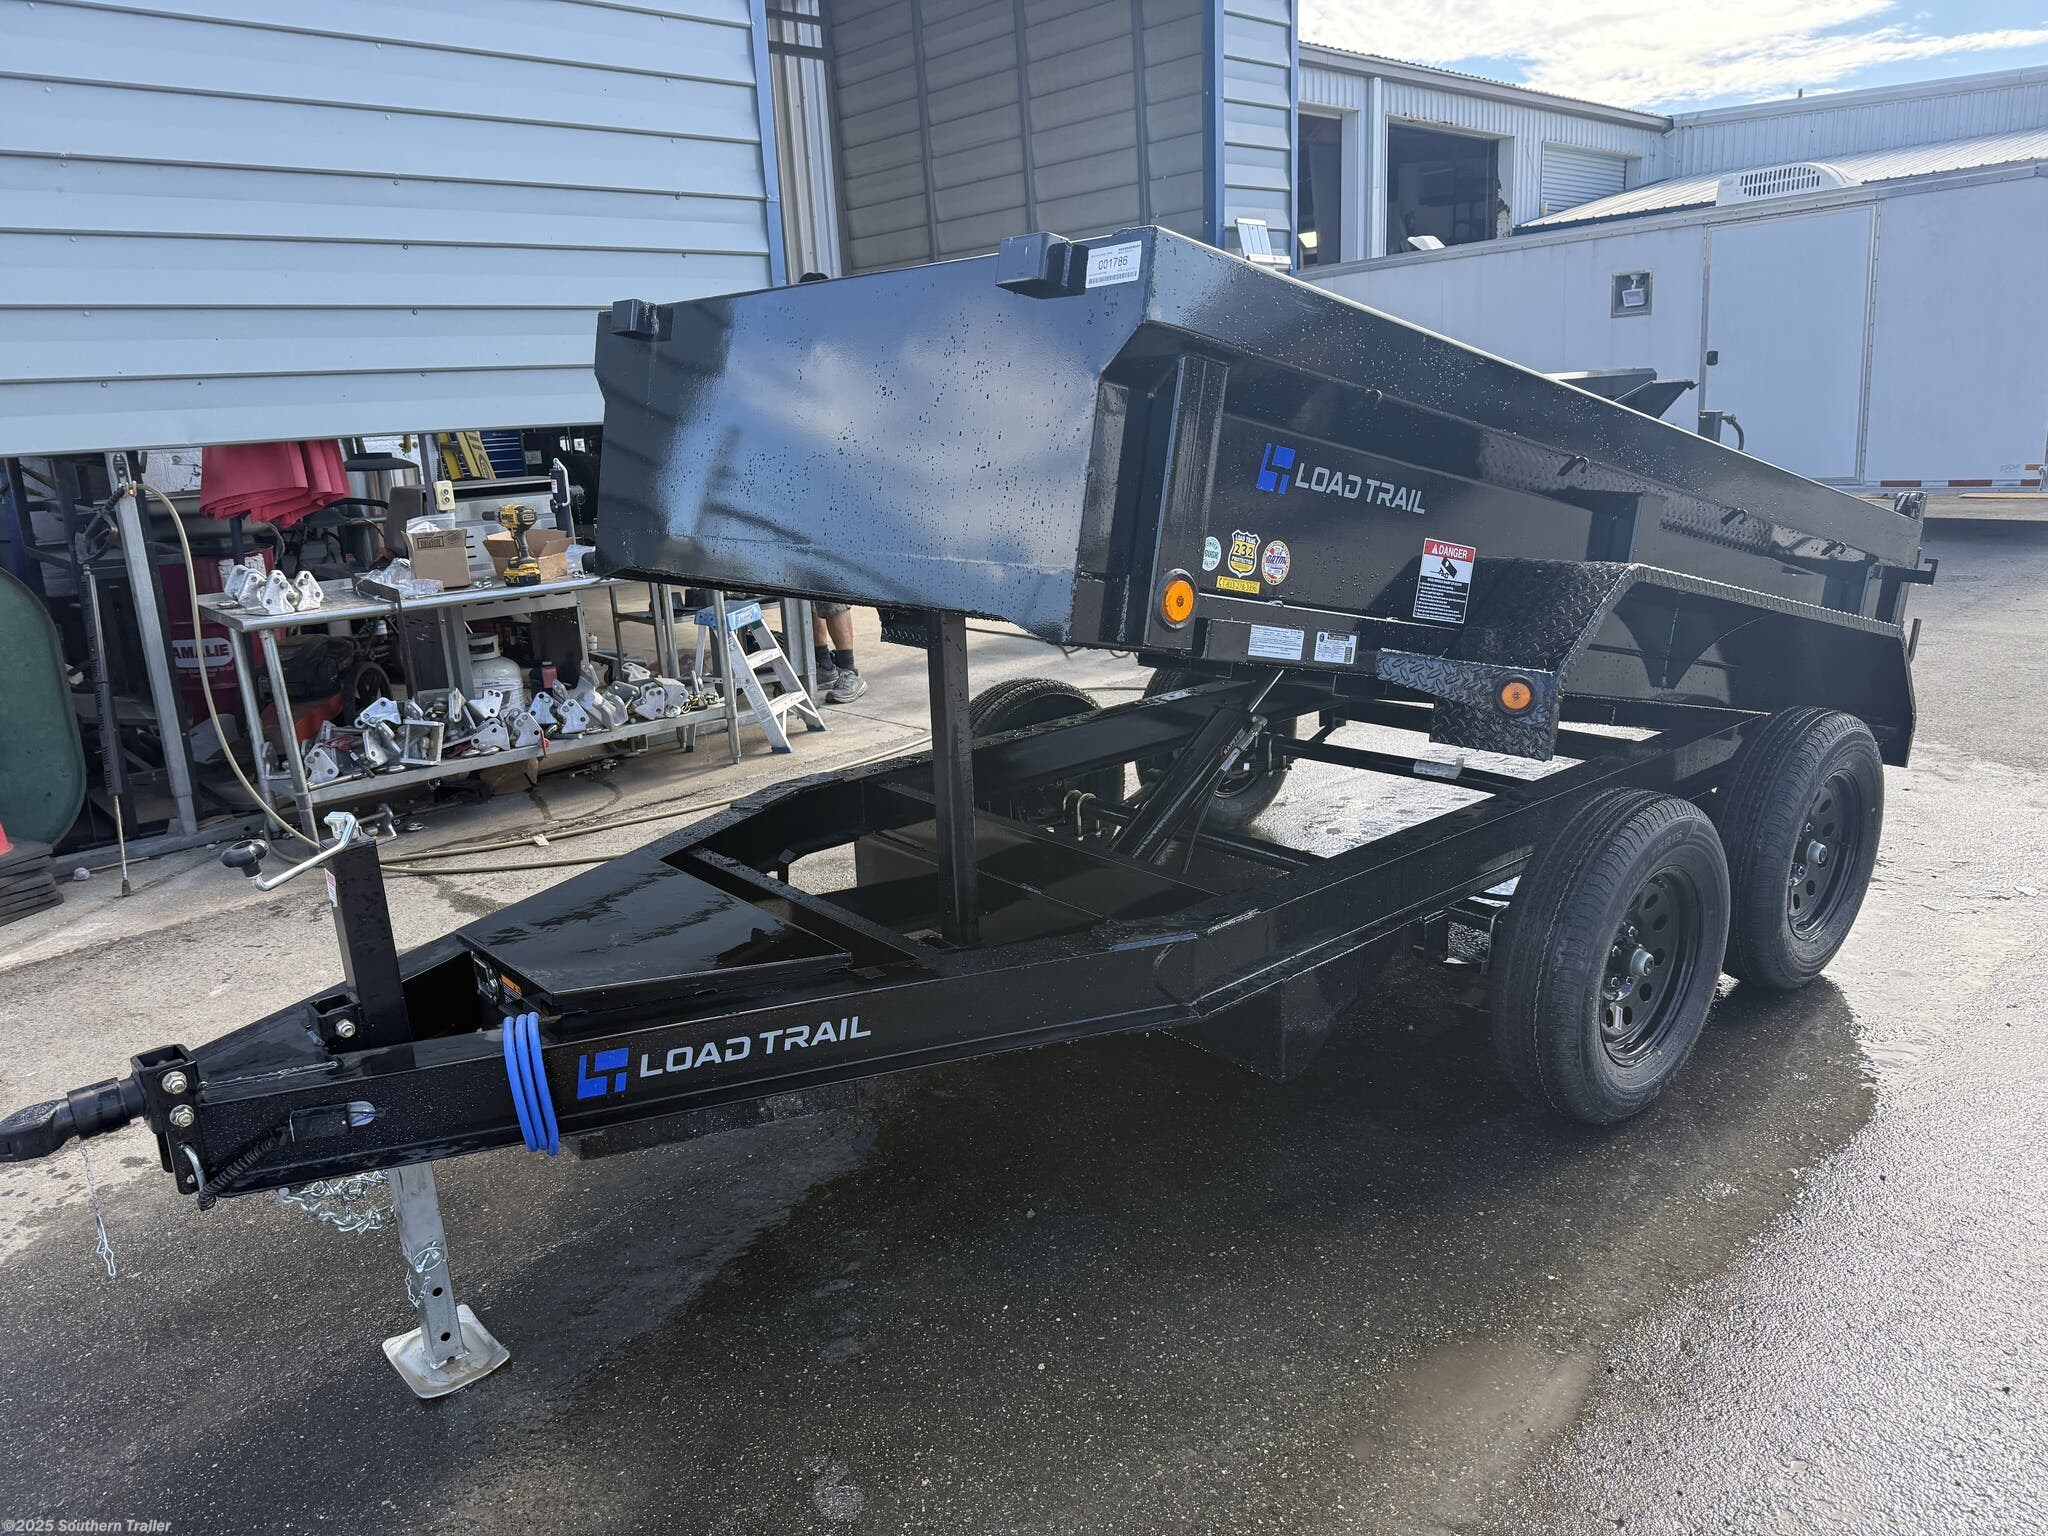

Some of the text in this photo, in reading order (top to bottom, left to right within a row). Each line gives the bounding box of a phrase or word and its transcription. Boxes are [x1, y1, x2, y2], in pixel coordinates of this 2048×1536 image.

[1098, 255, 1128, 270] 001786
[1295, 462, 1426, 514] LOAD TRAIL
[1234, 543, 1254, 557] 232
[1438, 545, 1468, 559] DANGER
[639, 1015, 872, 1078] LOAD TRAIL
